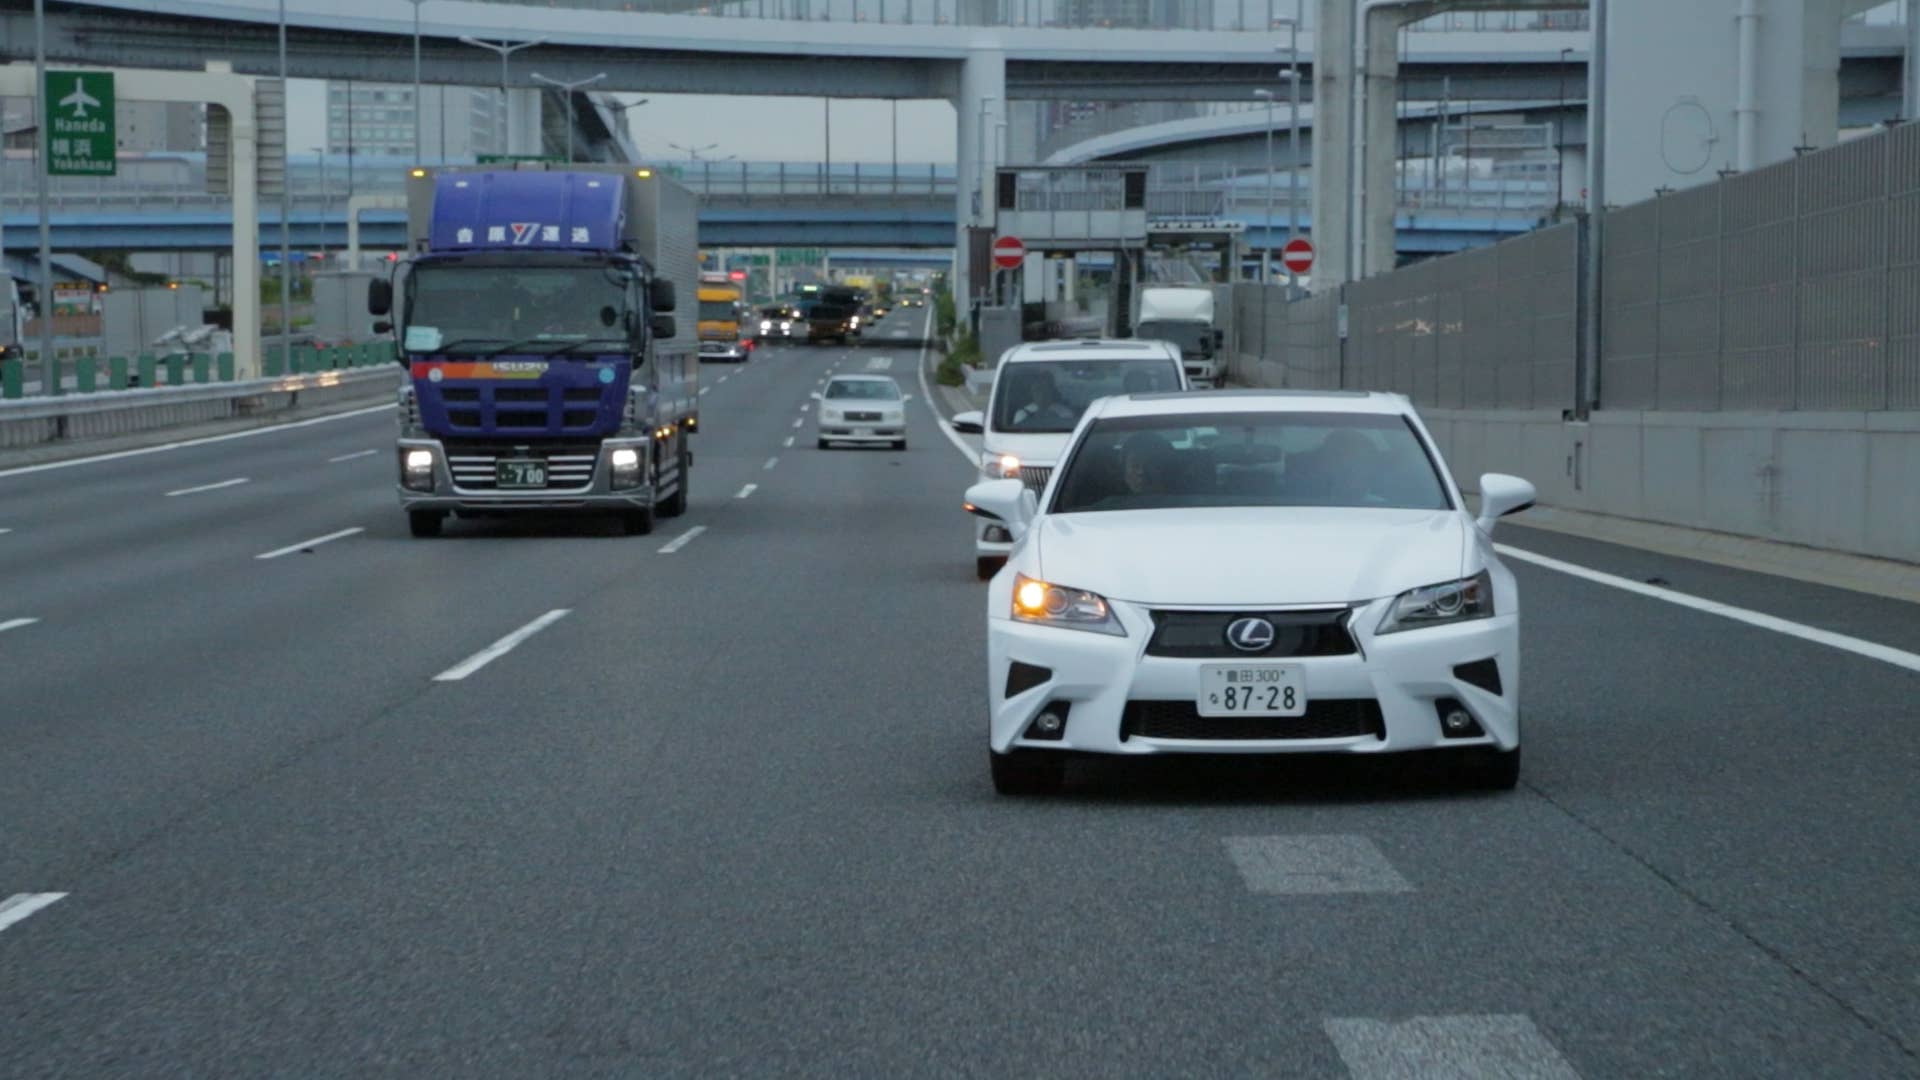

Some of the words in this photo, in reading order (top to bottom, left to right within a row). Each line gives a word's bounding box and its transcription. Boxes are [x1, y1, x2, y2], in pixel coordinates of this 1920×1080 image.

[55, 118, 106, 132] Haneda
[52, 139, 91, 156] 横浜
[54, 158, 113, 171] Yokohama
[493, 361, 549, 372] ISUZU
[1255, 670, 1280, 682] 300
[1225, 686, 1296, 711] 87-28
